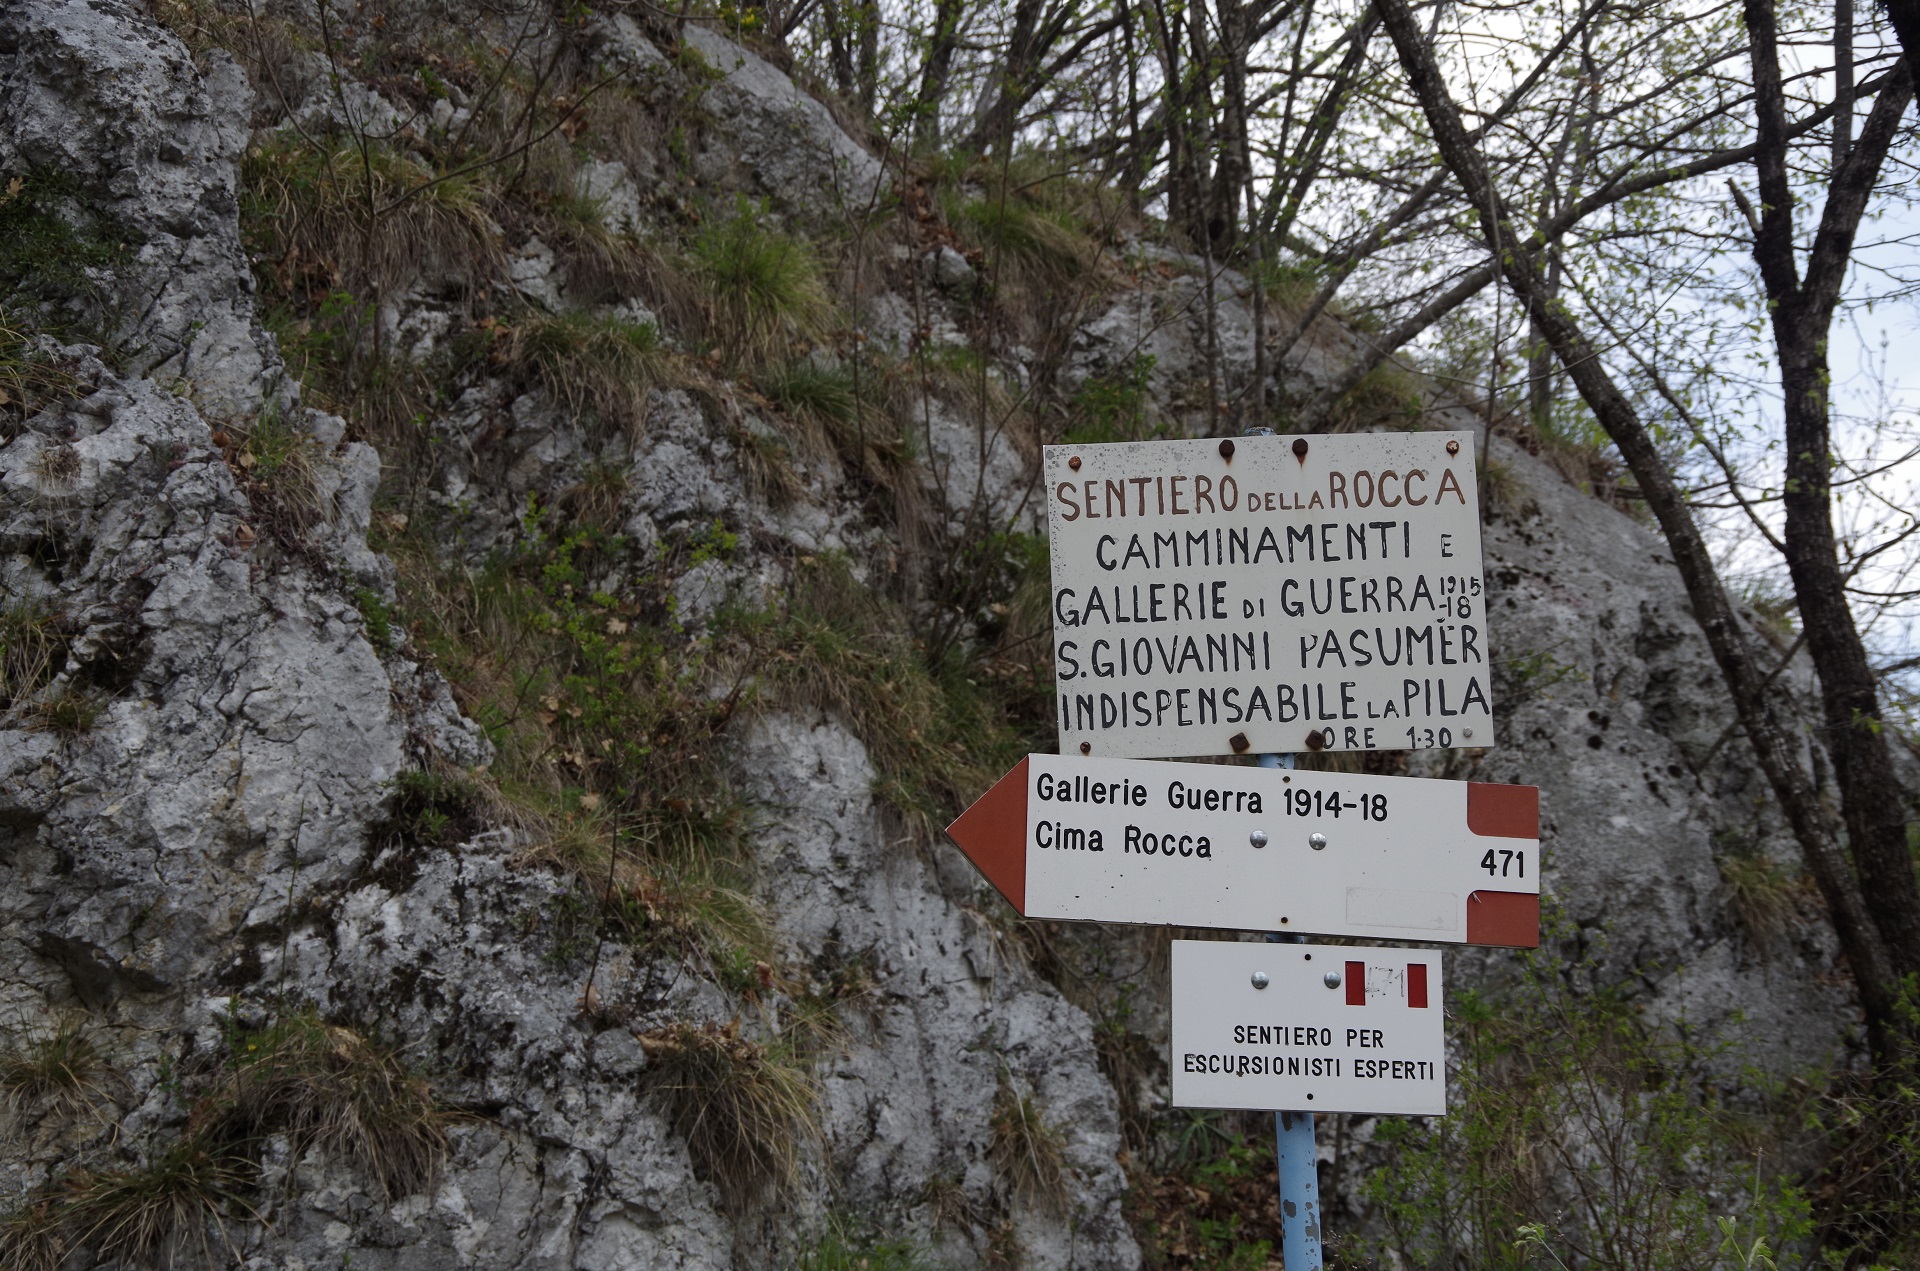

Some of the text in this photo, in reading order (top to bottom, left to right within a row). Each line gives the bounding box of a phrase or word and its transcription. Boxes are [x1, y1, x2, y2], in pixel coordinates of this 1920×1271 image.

[1056, 468, 1466, 521] SENTIERO DELLA ROCCA
[1096, 521, 1454, 571] CAMMINAMENTI E
[1055, 581, 1228, 626] GALLERIE
[1243, 598, 1265, 619] DI
[1281, 574, 1436, 618] GUERRA
[1063, 676, 1491, 731] INDISPENSABILE LA PILA
[1321, 726, 1376, 749] ORE
[1036, 773, 1388, 822] Gallerie Guerra 1914-18
[1034, 821, 1212, 859] Cima Rocca
[1480, 849, 1525, 879] 471
[1233, 1025, 1384, 1049] SENTIERO PER
[1184, 1053, 1435, 1081] ESCURSIONISTI ESPERTI
